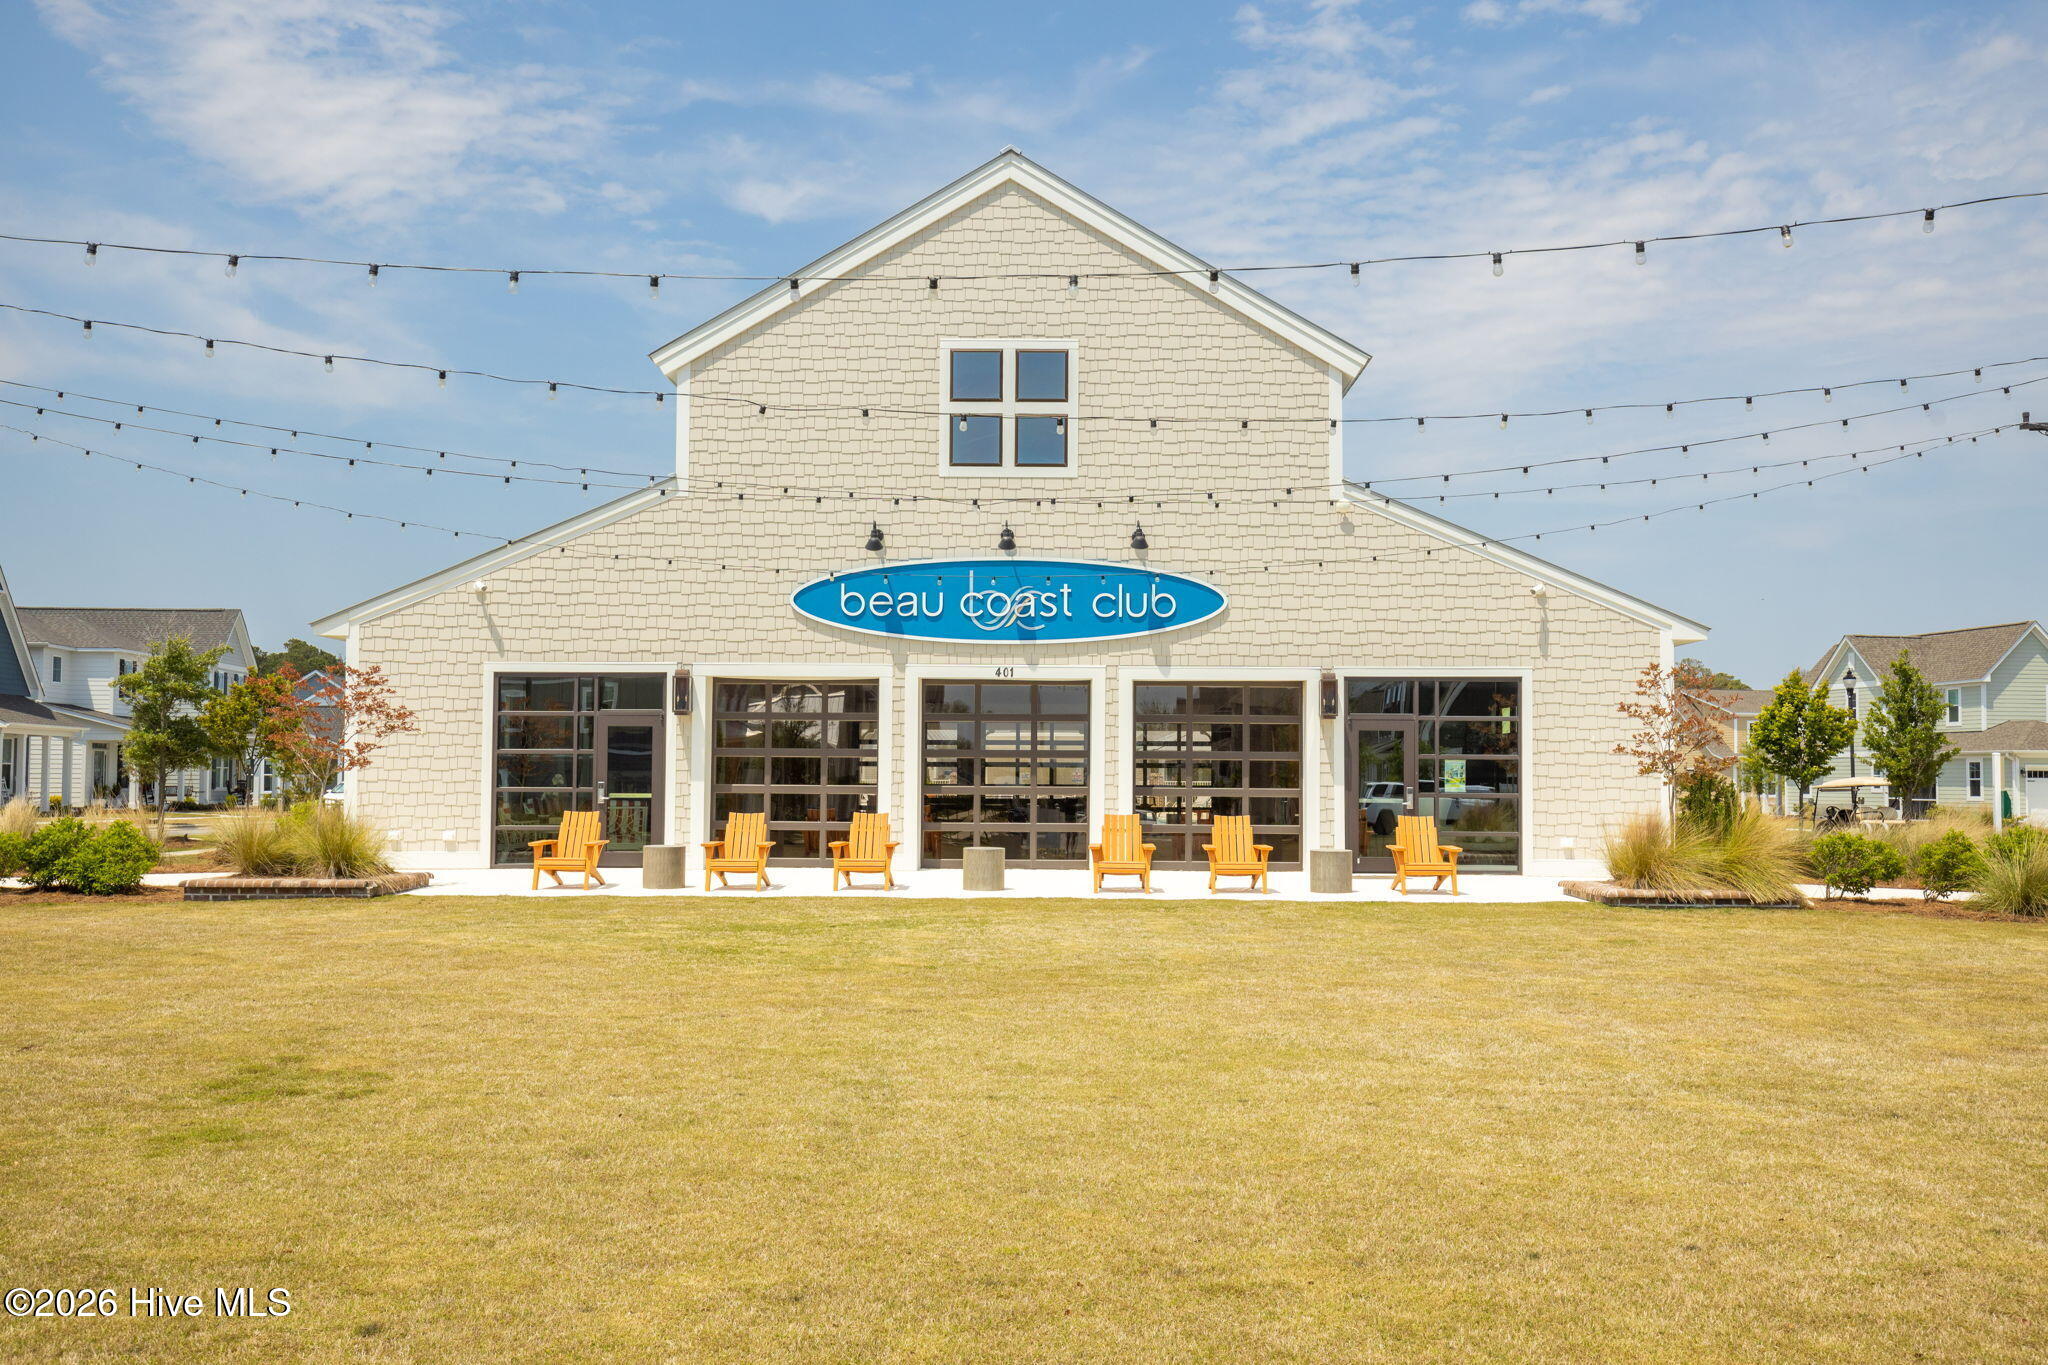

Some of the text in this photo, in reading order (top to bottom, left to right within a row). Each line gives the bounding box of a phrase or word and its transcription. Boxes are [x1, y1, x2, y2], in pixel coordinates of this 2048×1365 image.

[840, 583, 1177, 618] beau coast club
[995, 666, 1015, 679] 401
